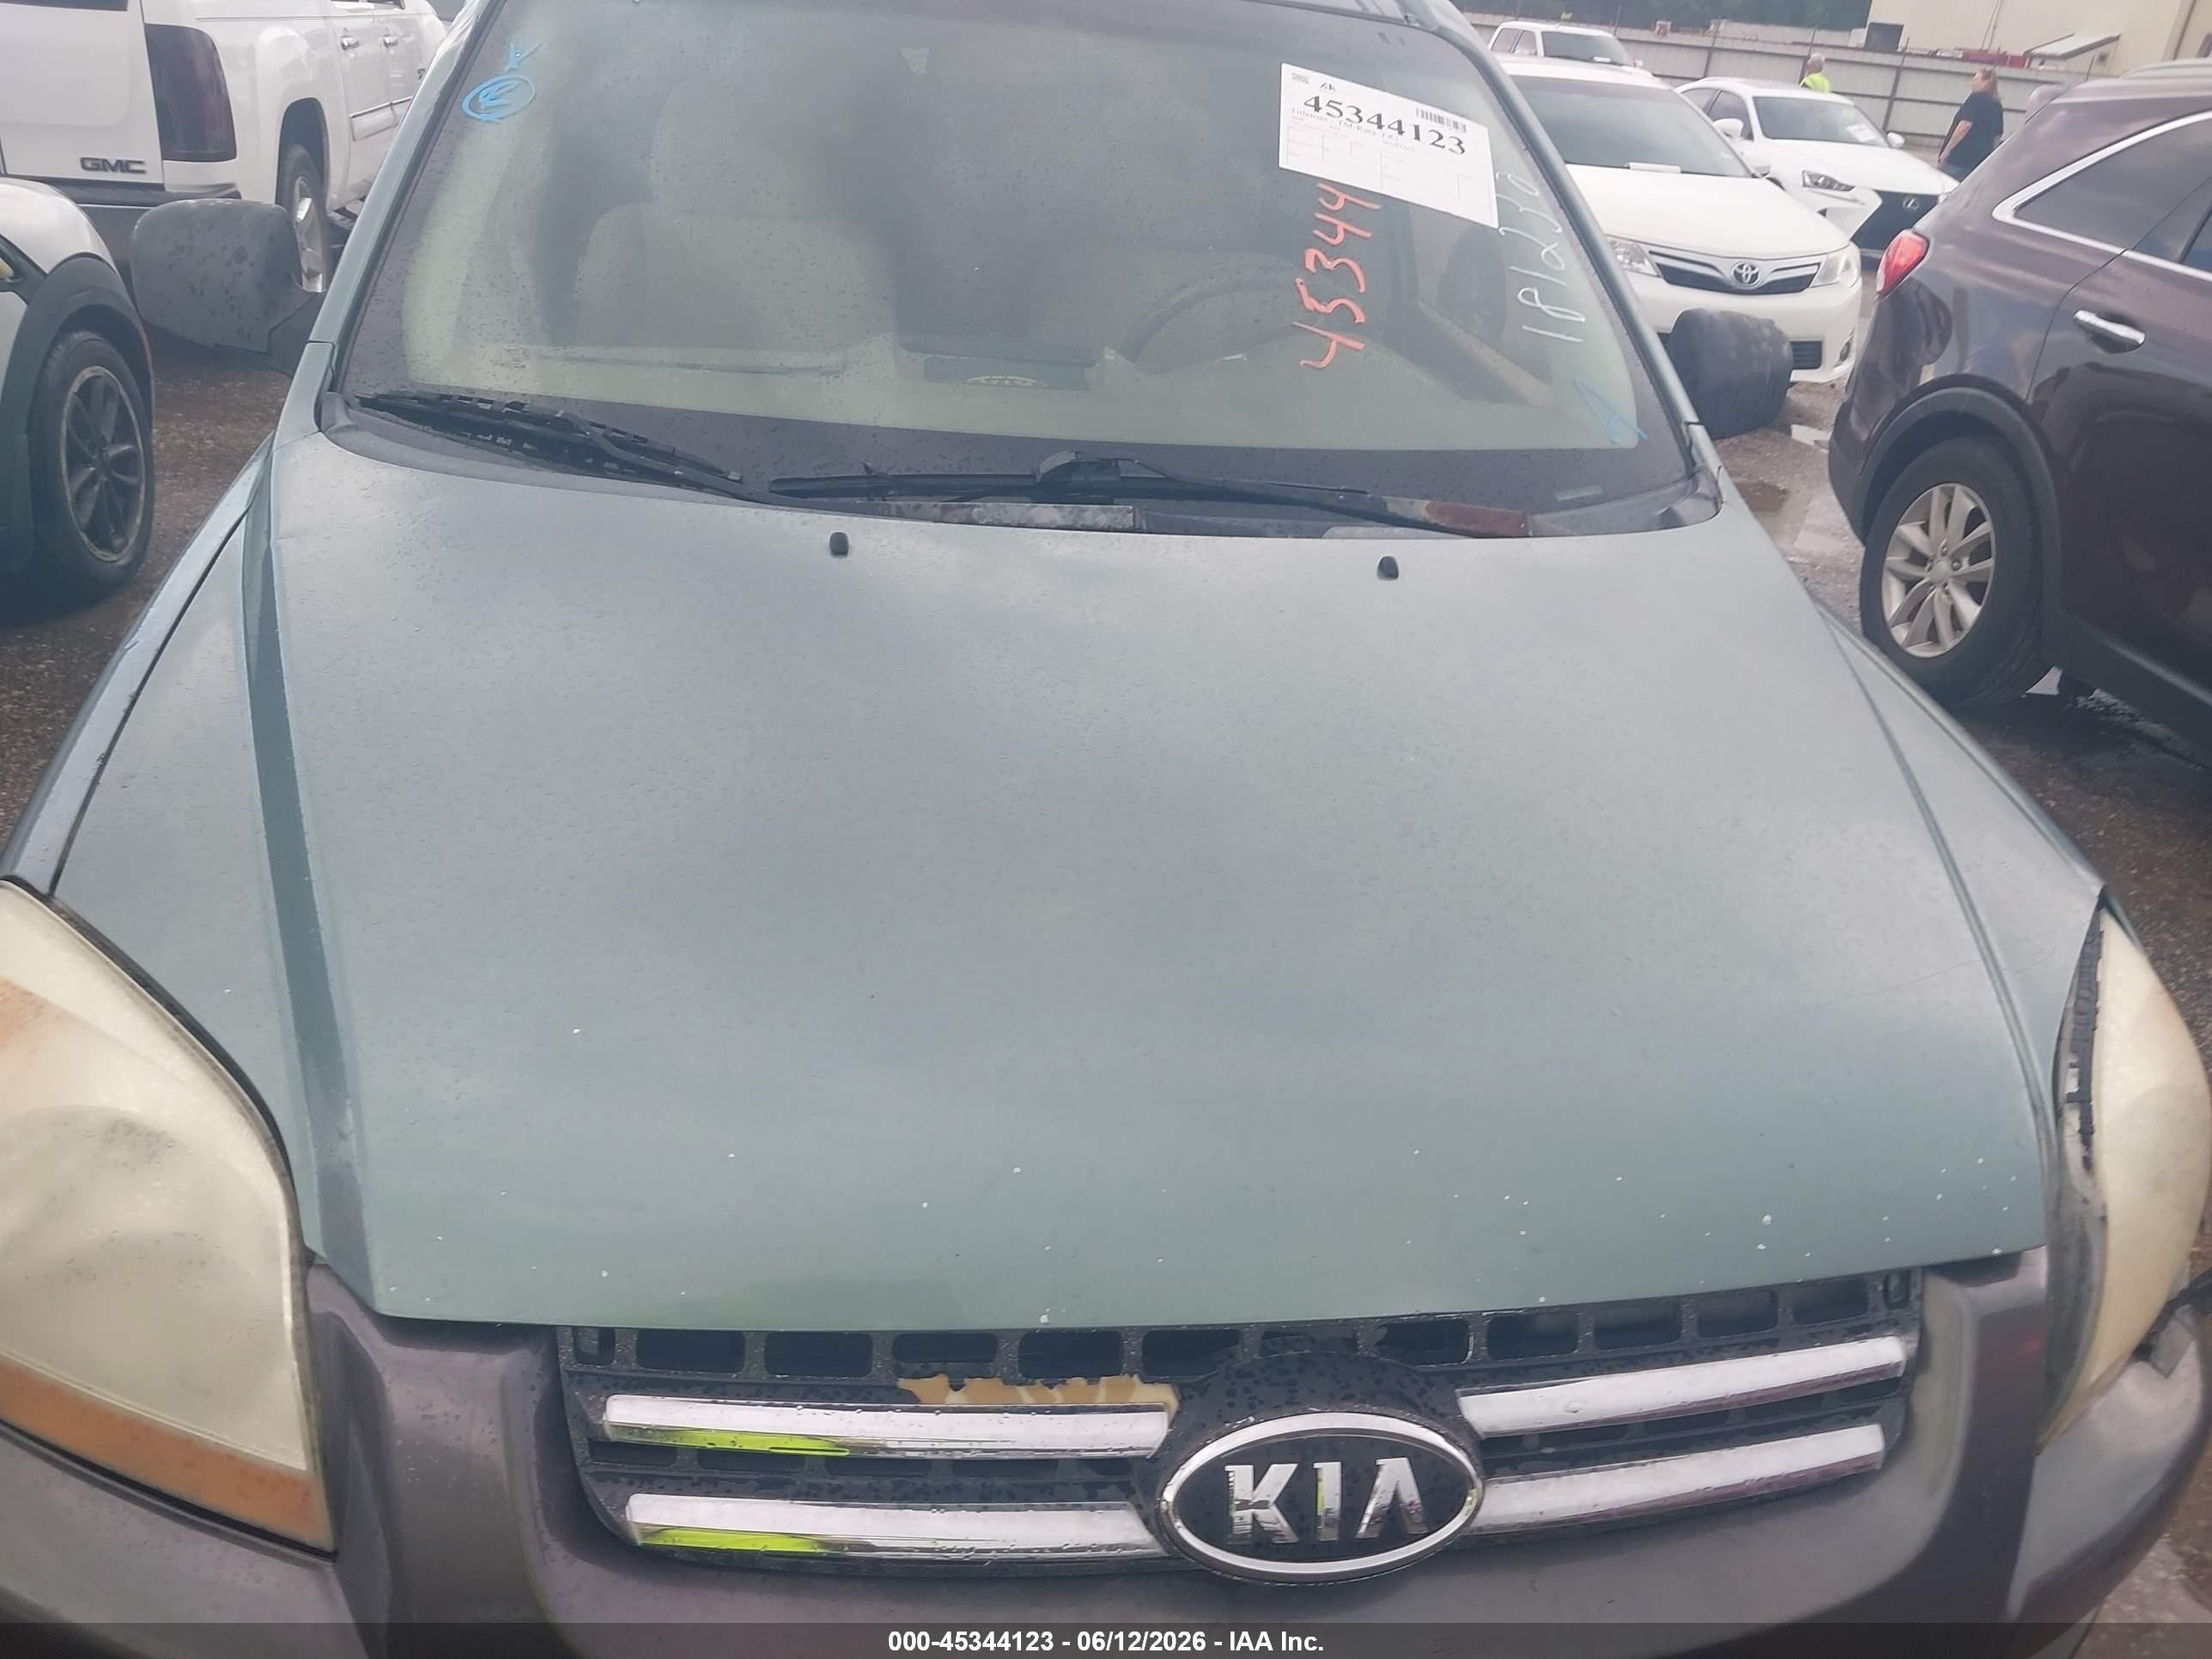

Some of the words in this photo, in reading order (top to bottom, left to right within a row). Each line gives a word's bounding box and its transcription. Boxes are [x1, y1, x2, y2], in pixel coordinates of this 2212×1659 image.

[1304, 96, 1466, 155] 45344123
[80, 157, 147, 174] GMC
[1291, 182, 1381, 369] 45344
[1224, 1456, 1429, 1545] KIA
